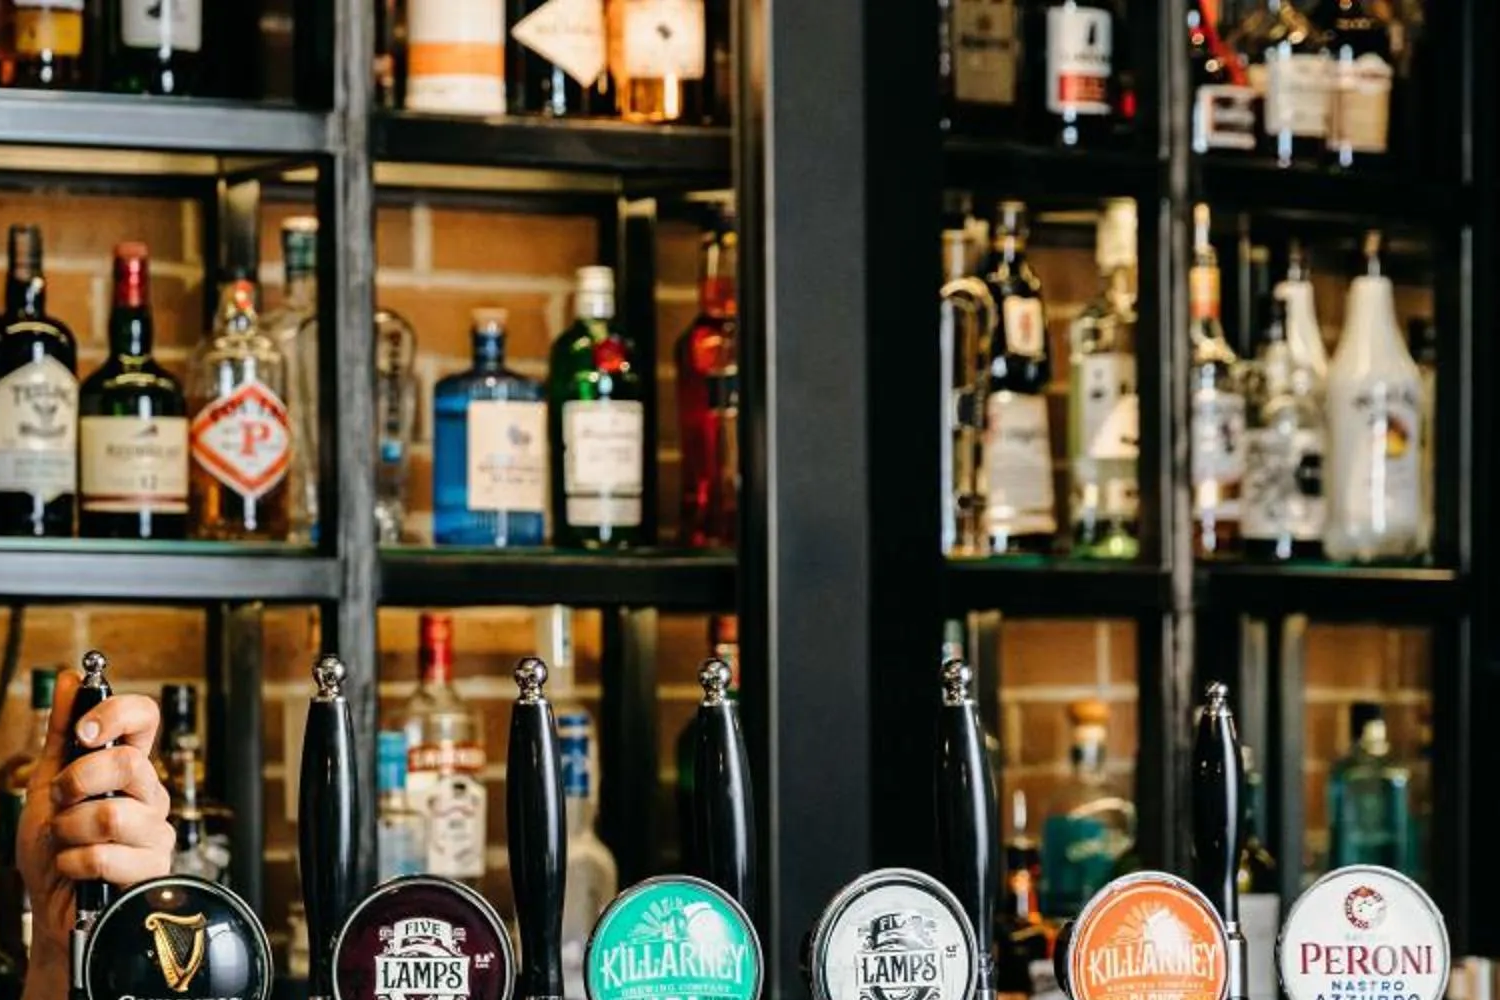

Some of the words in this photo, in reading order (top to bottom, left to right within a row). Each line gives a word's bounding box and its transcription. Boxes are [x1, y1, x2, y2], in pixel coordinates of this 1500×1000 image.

[404, 921, 442, 936] FIVE
[600, 940, 745, 991] KILLARNEY
[861, 954, 937, 984] LAMPS
[1300, 942, 1434, 976] PERONI
[381, 961, 463, 989] LAMPS
[1331, 980, 1404, 991] NASTRO
